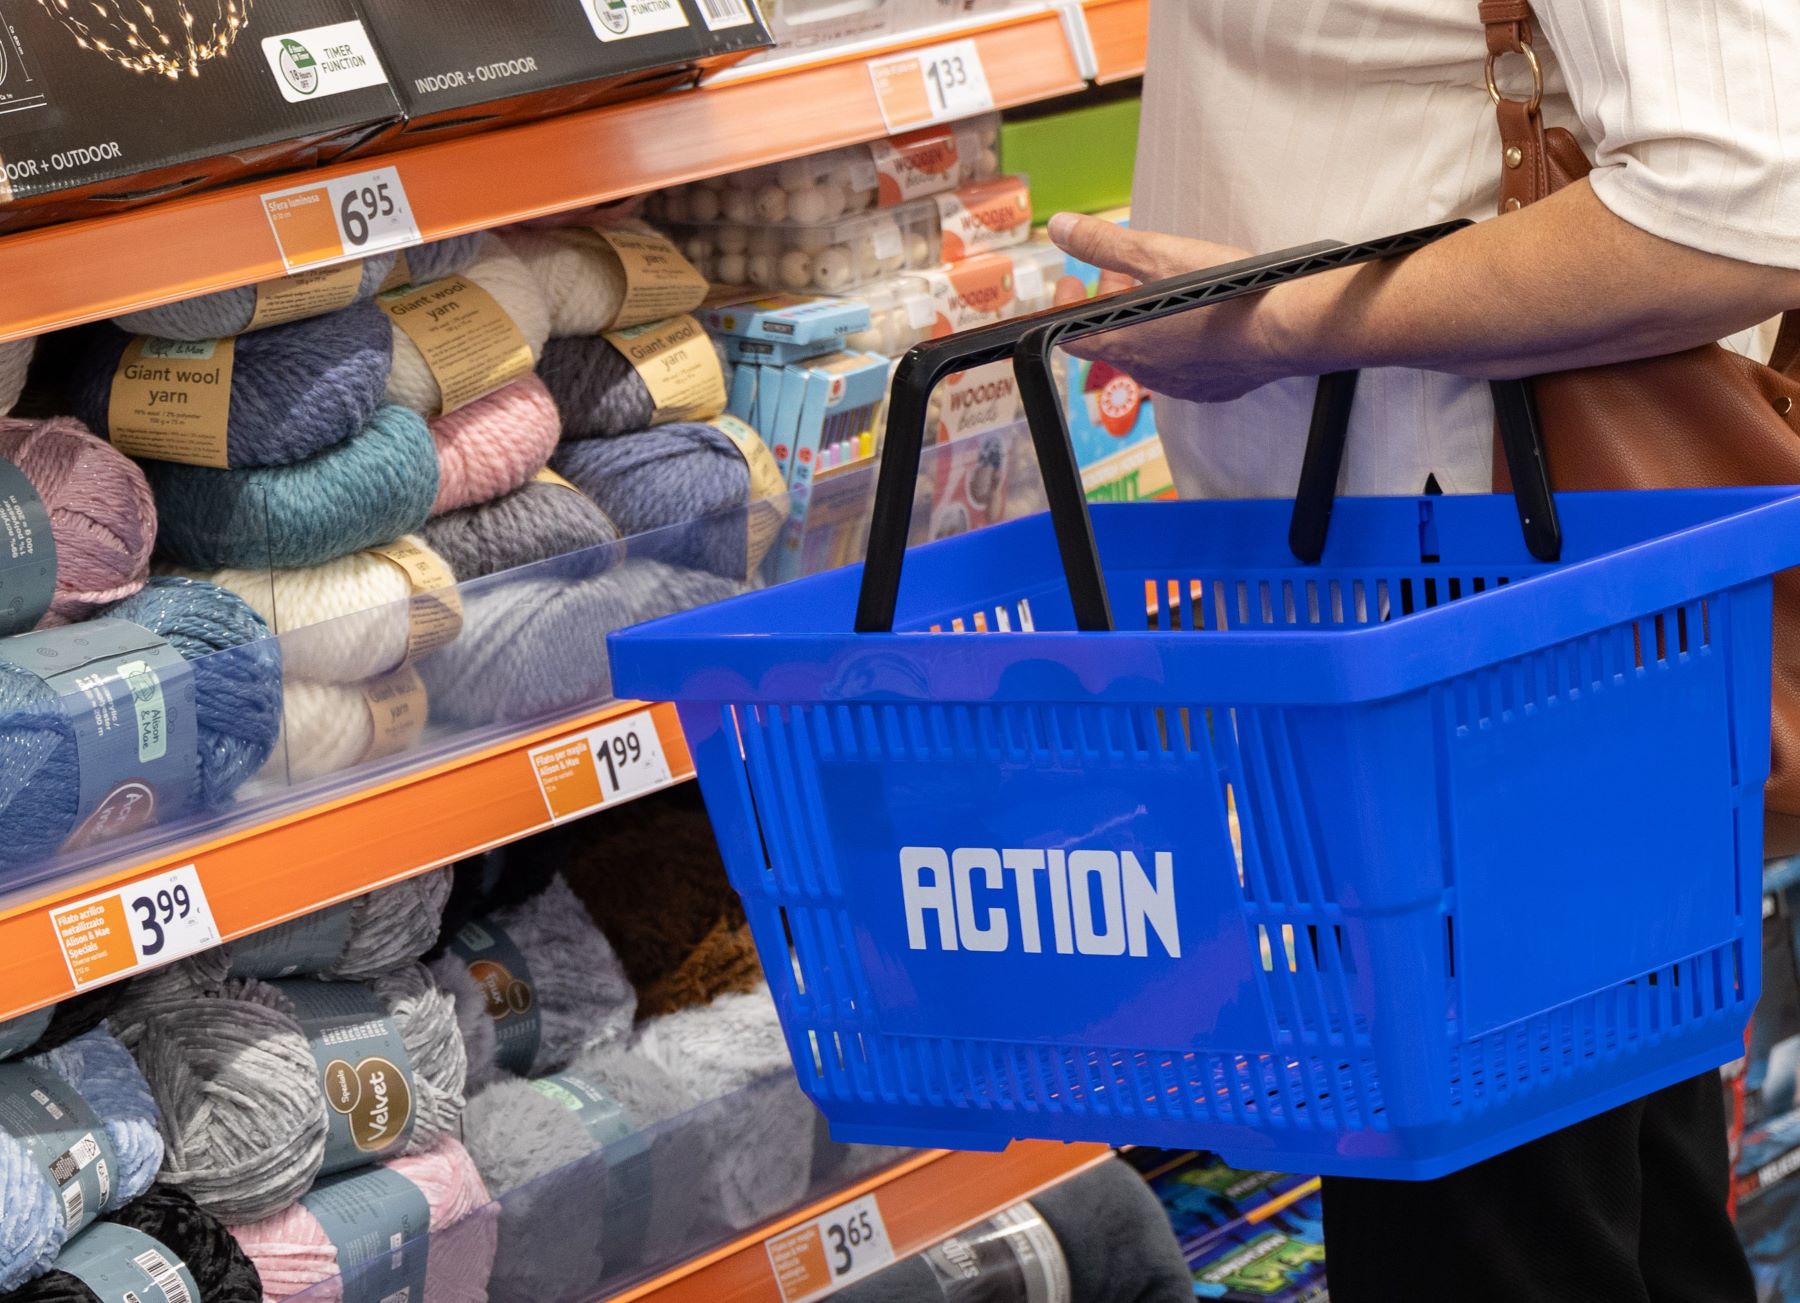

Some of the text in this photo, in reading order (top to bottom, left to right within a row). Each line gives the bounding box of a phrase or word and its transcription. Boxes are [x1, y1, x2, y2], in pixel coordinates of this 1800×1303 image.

[631, 0, 670, 15] FUNCTION
[323, 45, 353, 60] TIMER
[321, 56, 366, 74] FUNCTION
[415, 57, 538, 94] INDOOR + OUTDOOR
[41, 160, 49, 172] +
[51, 142, 122, 170] OUTDOOR
[893, 150, 943, 174] WOODEN
[268, 200, 288, 212] Sfera
[960, 206, 1015, 230] WOODEN
[391, 282, 467, 316] Giant wool
[949, 286, 998, 310] WOODEN
[426, 301, 460, 322] yarn
[186, 345, 205, 355] Mae
[630, 323, 695, 360] Giant wool
[661, 350, 688, 372] yarn
[124, 365, 220, 384] Giant wool
[148, 390, 188, 406] yarn
[951, 377, 1014, 411] WOODEN
[957, 402, 997, 431] beads
[9, 495, 17, 503] m
[3, 500, 24, 540] polyester
[14, 505, 25, 520] 200
[390, 703, 409, 723] yarn
[141, 710, 151, 750] & Mae
[151, 709, 161, 744] Alison
[899, 846, 1181, 958] ACTION
[58, 905, 105, 927] Filato acrilico
[62, 917, 105, 937] metallizzato
[66, 928, 111, 948] Alison & Mae
[68, 942, 98, 958] Specials
[337, 1069, 351, 1104] Specials
[368, 1071, 389, 1141] Velvet
